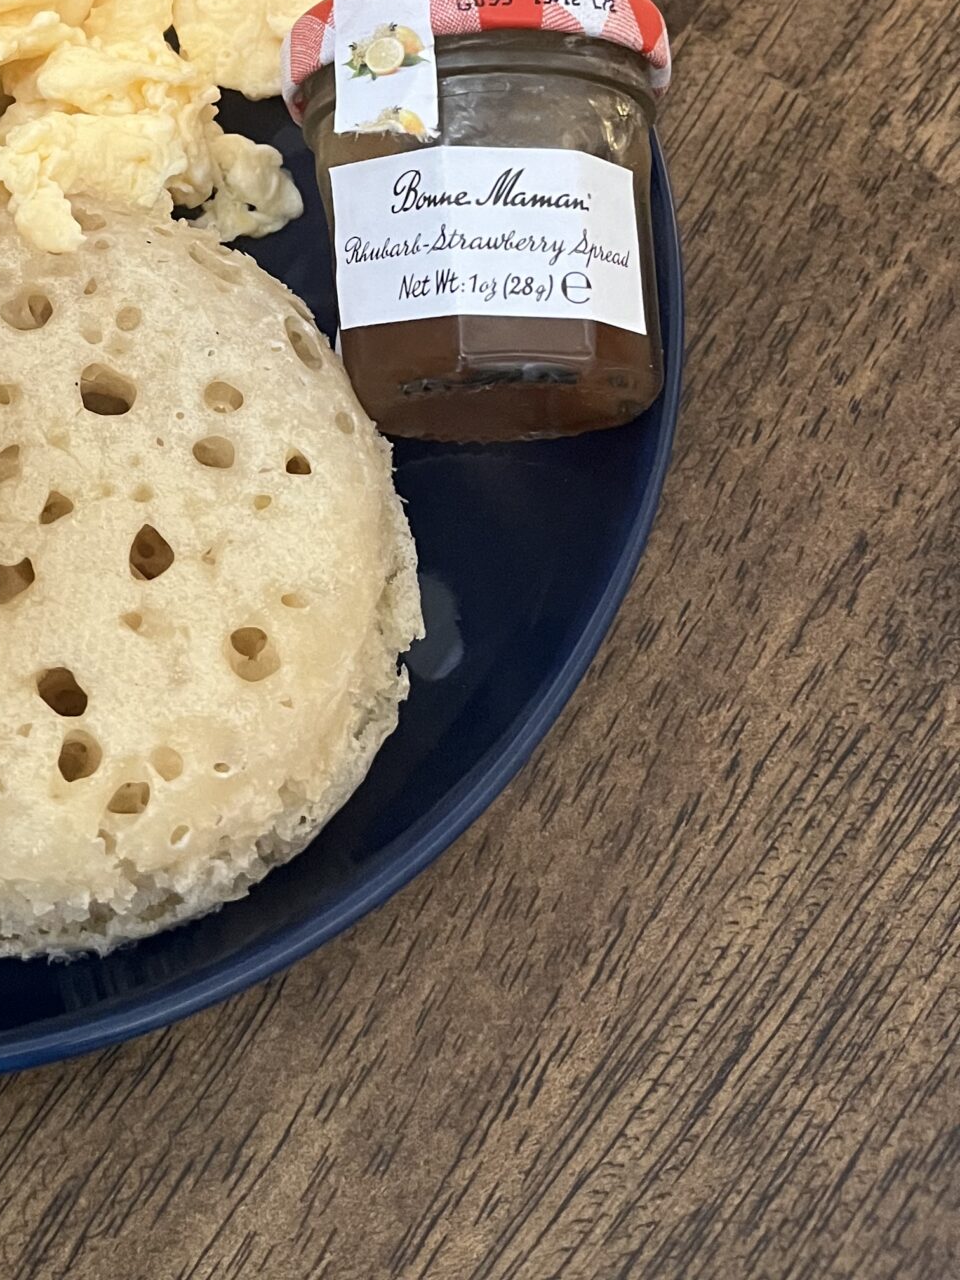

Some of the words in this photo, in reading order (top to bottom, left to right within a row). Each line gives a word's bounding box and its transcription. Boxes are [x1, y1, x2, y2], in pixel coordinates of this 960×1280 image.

[391, 169, 471, 214] Bonne
[476, 167, 592, 212] Maman
[344, 223, 565, 267] Rhubarb-Strawberry
[567, 228, 631, 269] Spread
[398, 273, 431, 300] Net
[435, 269, 466, 294] Wt:
[469, 273, 498, 302] 1oz
[503, 274, 554, 302] (28g)
